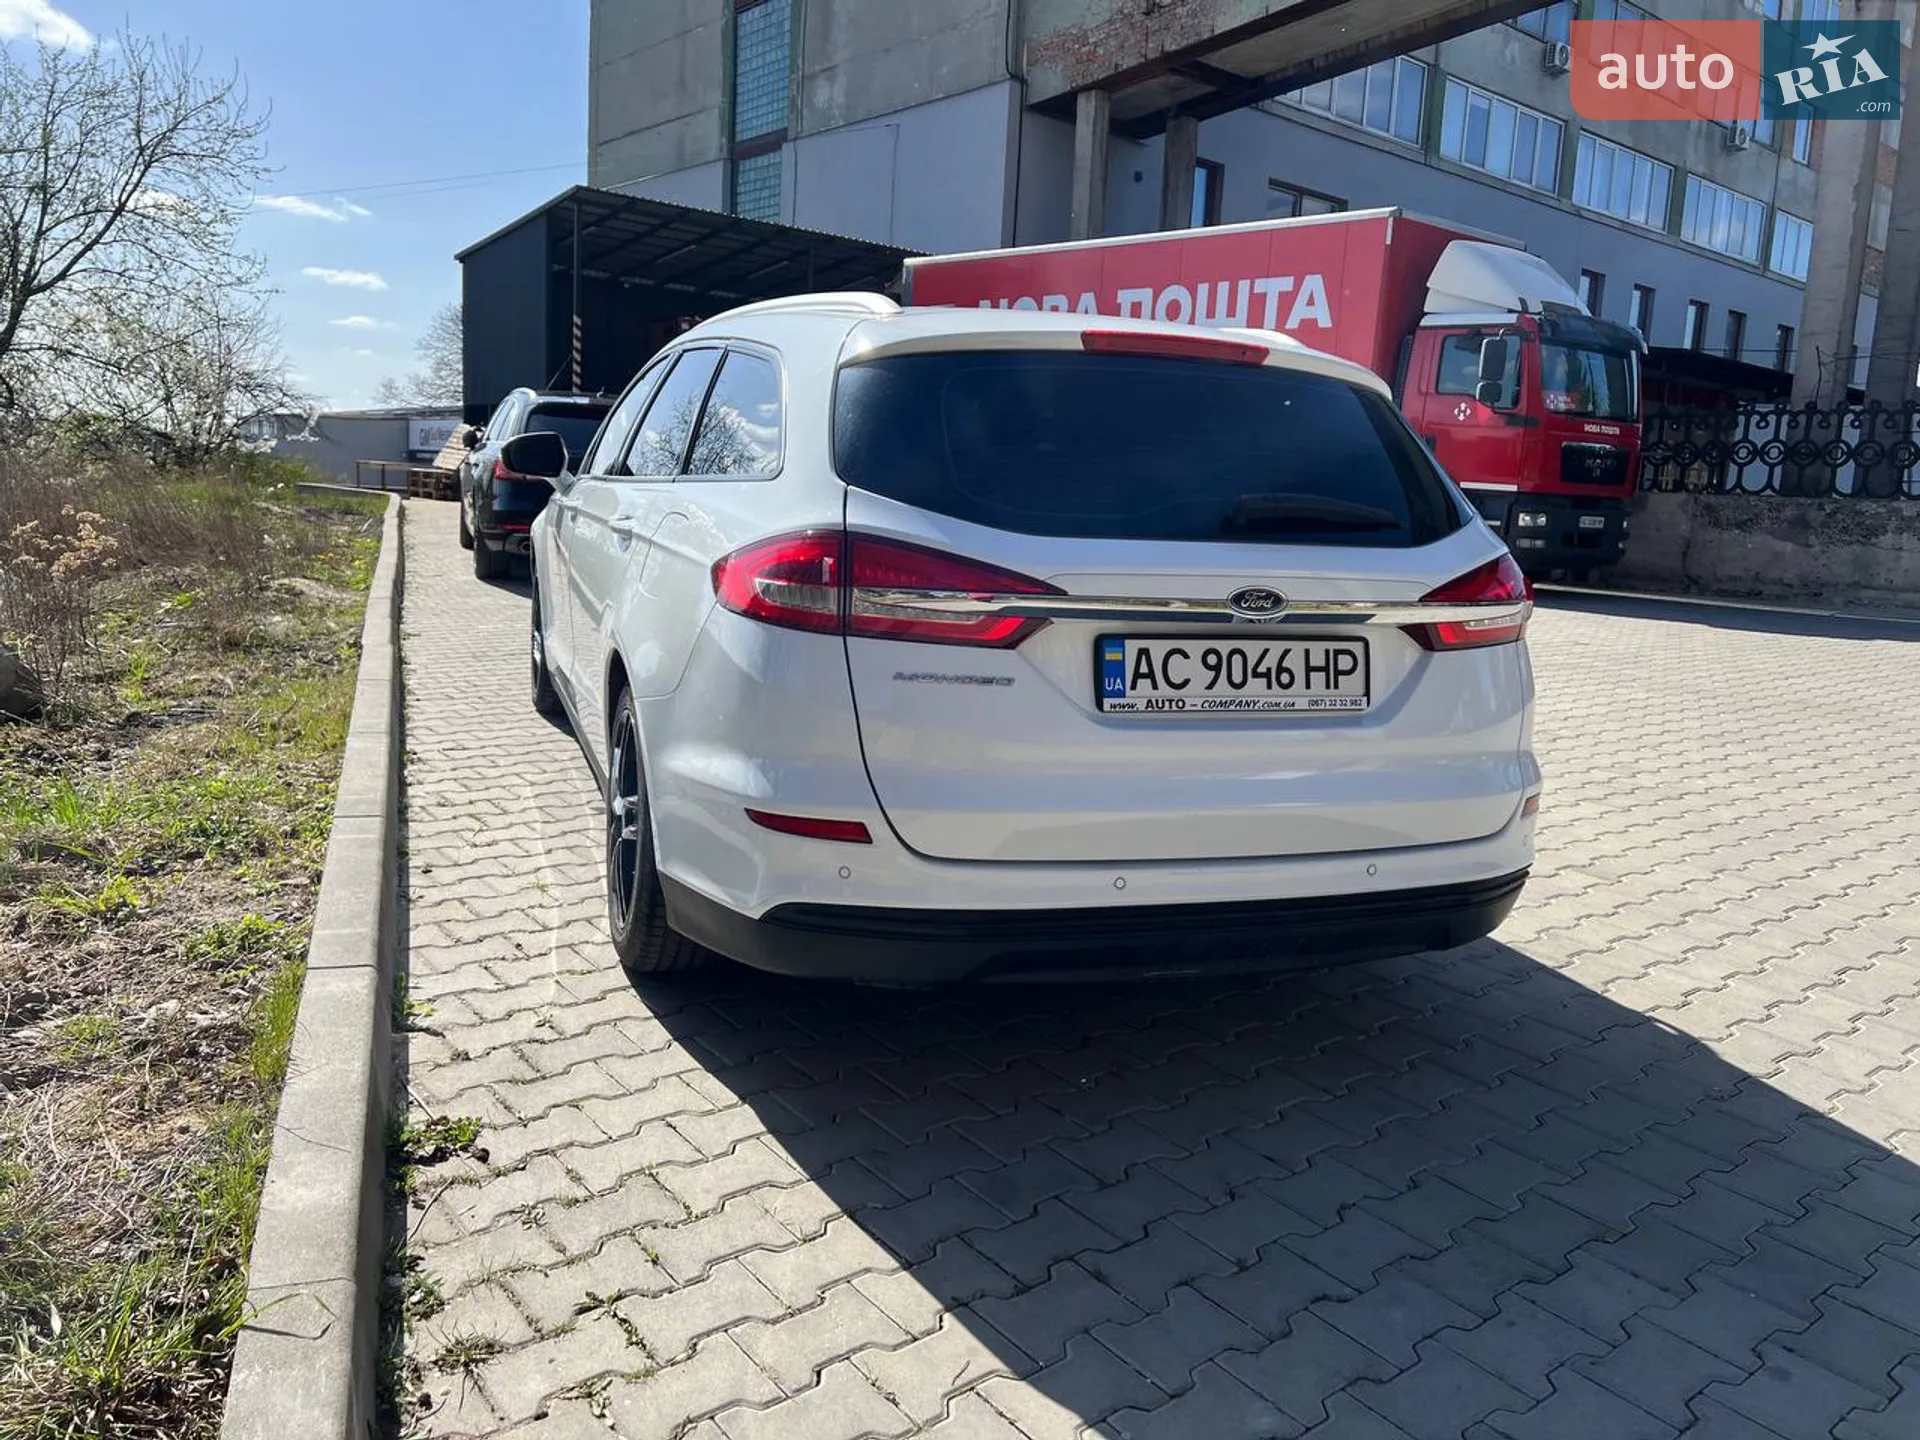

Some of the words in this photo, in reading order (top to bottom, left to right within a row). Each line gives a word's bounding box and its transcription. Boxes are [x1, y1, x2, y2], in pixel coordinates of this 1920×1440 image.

[1117, 274, 1333, 329] ПОШТА
[1240, 591, 1275, 608] Ford
[1130, 647, 1191, 691] AC
[1201, 647, 1296, 691] 9046
[1304, 647, 1359, 690] HP
[1105, 678, 1124, 691] UA
[1145, 698, 1186, 710] AUTO
